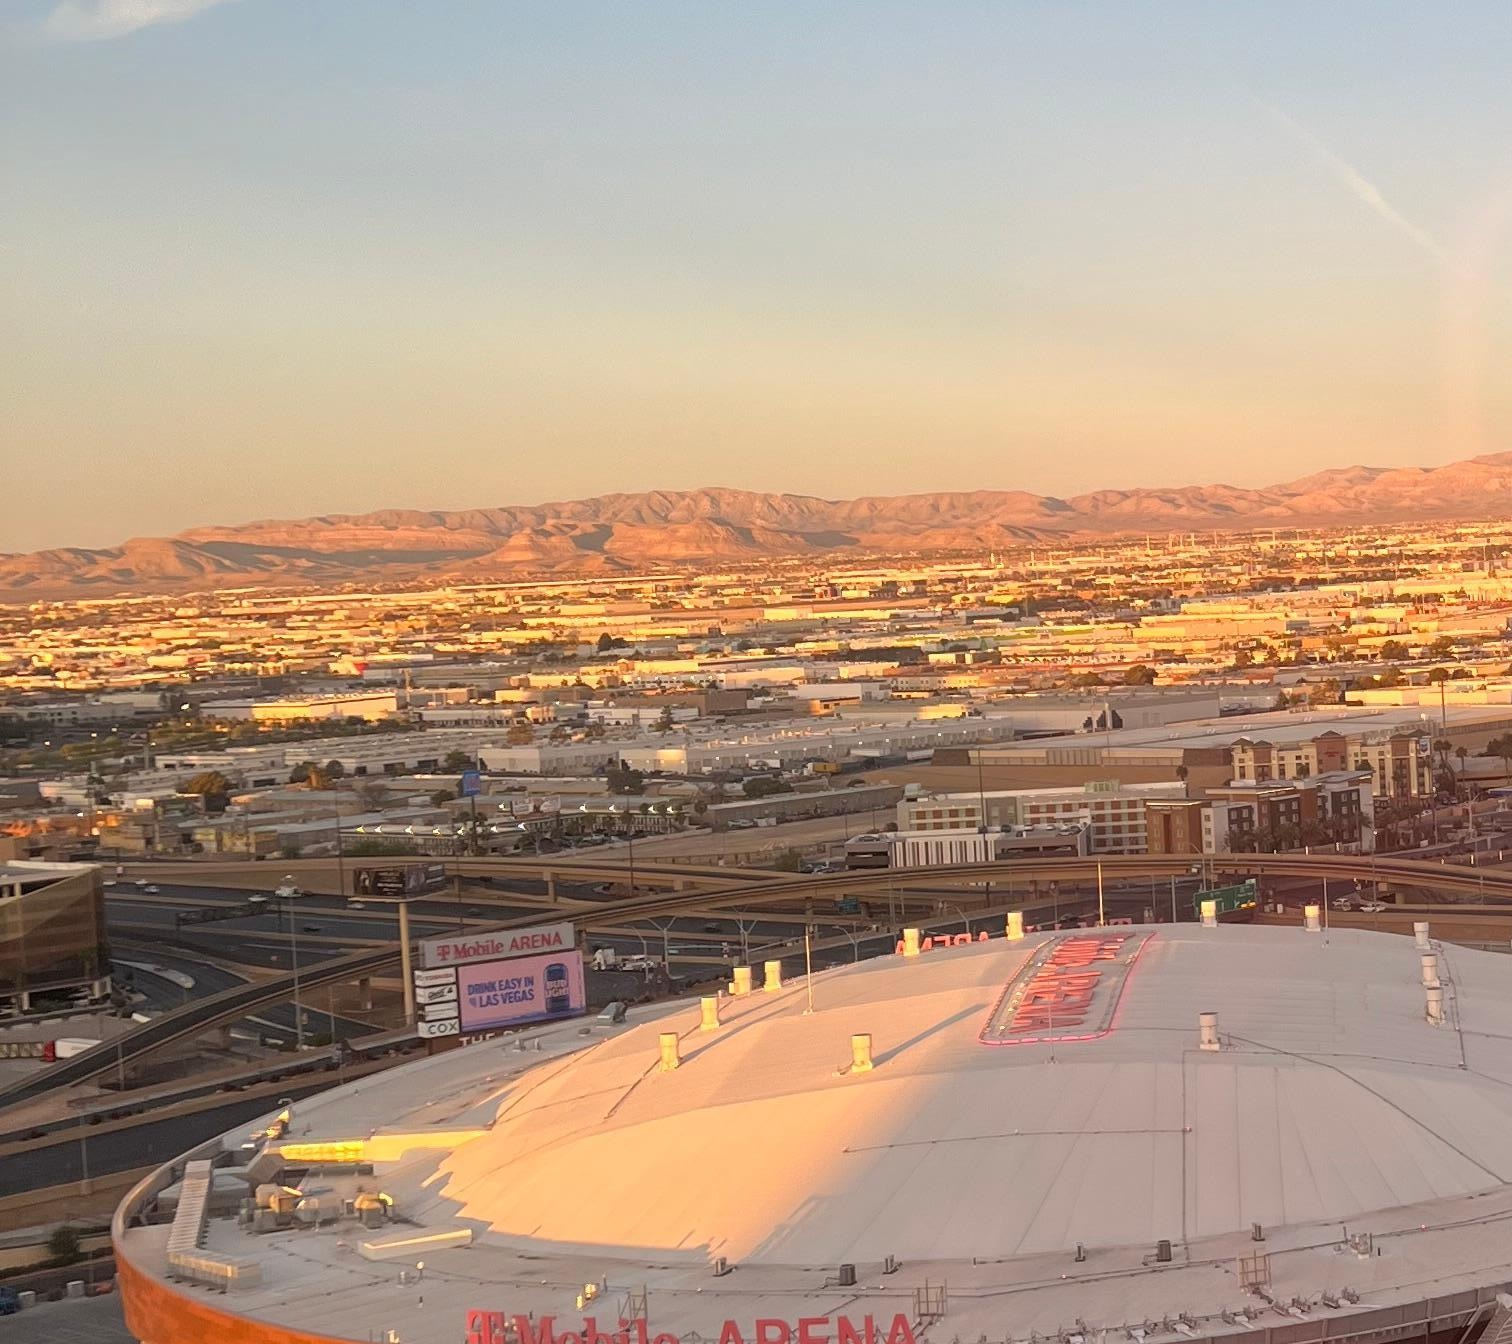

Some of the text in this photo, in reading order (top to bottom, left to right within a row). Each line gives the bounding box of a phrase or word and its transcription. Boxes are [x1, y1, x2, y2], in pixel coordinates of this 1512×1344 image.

[509, 931, 563, 952] ARENA
[467, 981, 497, 995] DRINK
[499, 977, 521, 991] EASY
[523, 975, 534, 987] IN
[479, 989, 535, 1007] LAS VEGAS
[428, 1020, 458, 1035] COX
